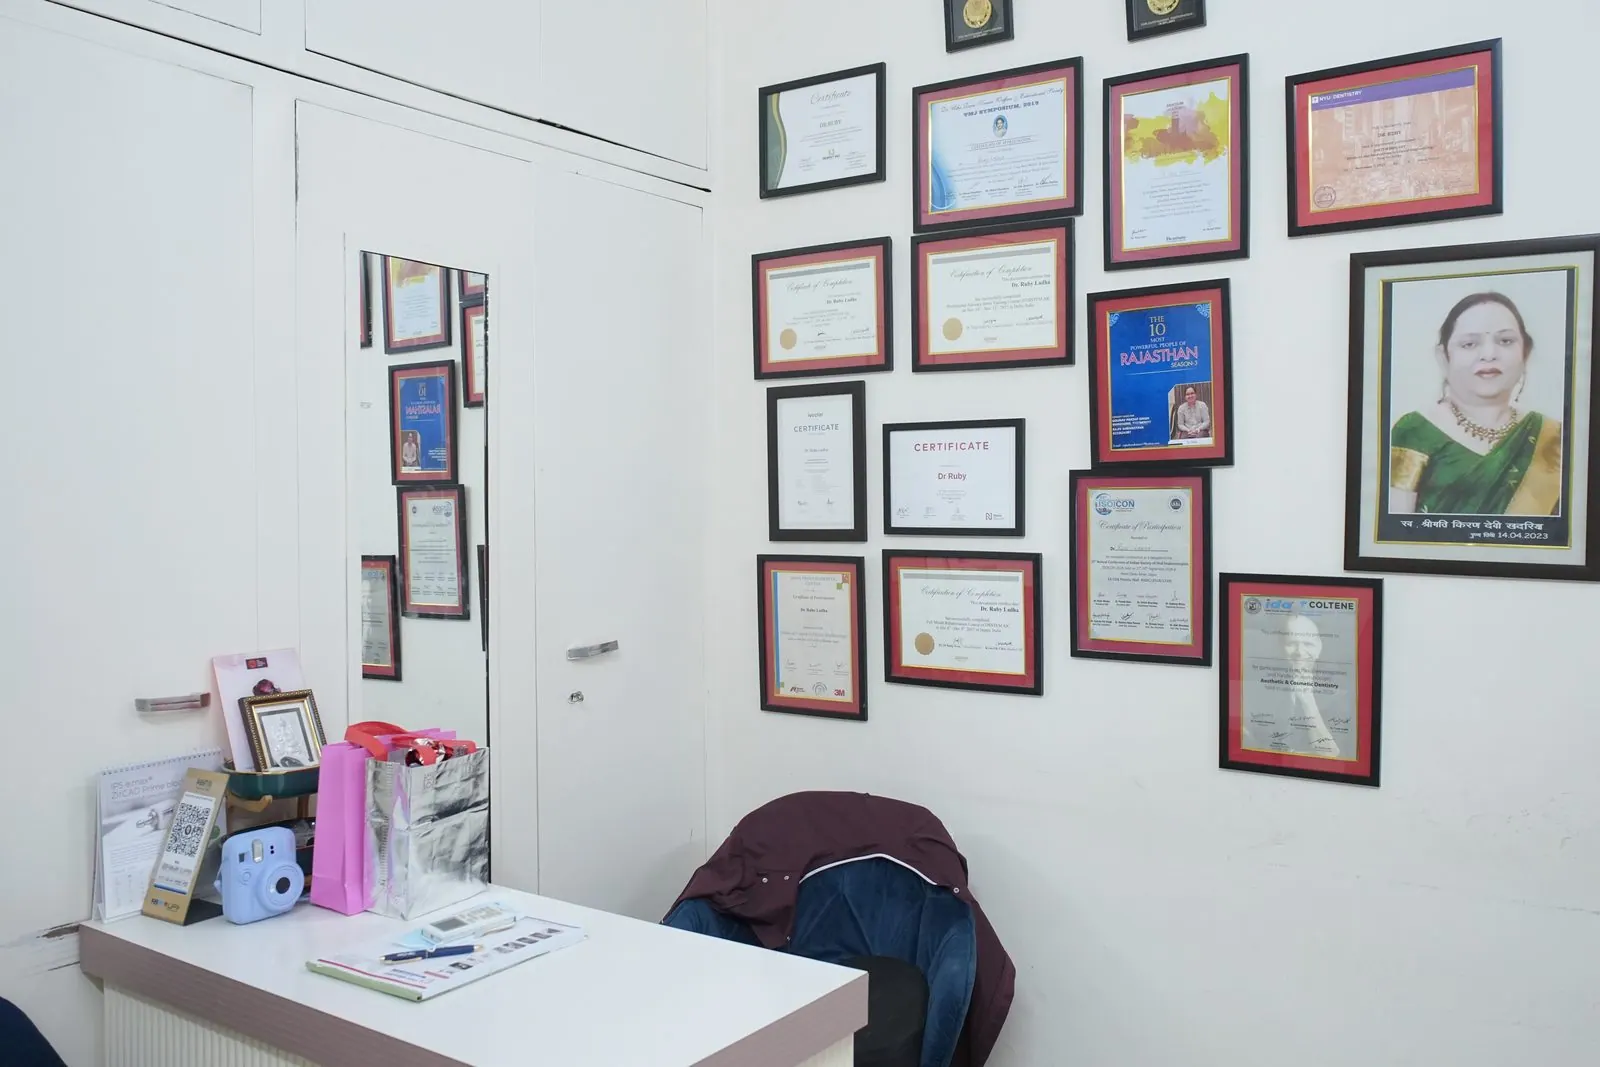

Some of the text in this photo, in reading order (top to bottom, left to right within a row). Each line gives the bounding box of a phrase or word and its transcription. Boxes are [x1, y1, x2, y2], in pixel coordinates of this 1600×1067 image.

[1333, 90, 1362, 100] DENTISTRY
[1150, 324, 1166, 336] 10
[1120, 346, 1198, 366] RAJASTHAN
[794, 424, 839, 432] CERTIFICATE
[914, 442, 989, 452] CERTIFICATE
[948, 473, 967, 481] Ruby
[1099, 519, 1132, 532] Certificate
[1452, 520, 1480, 529] किरण
[1309, 601, 1354, 610] COLTENE
